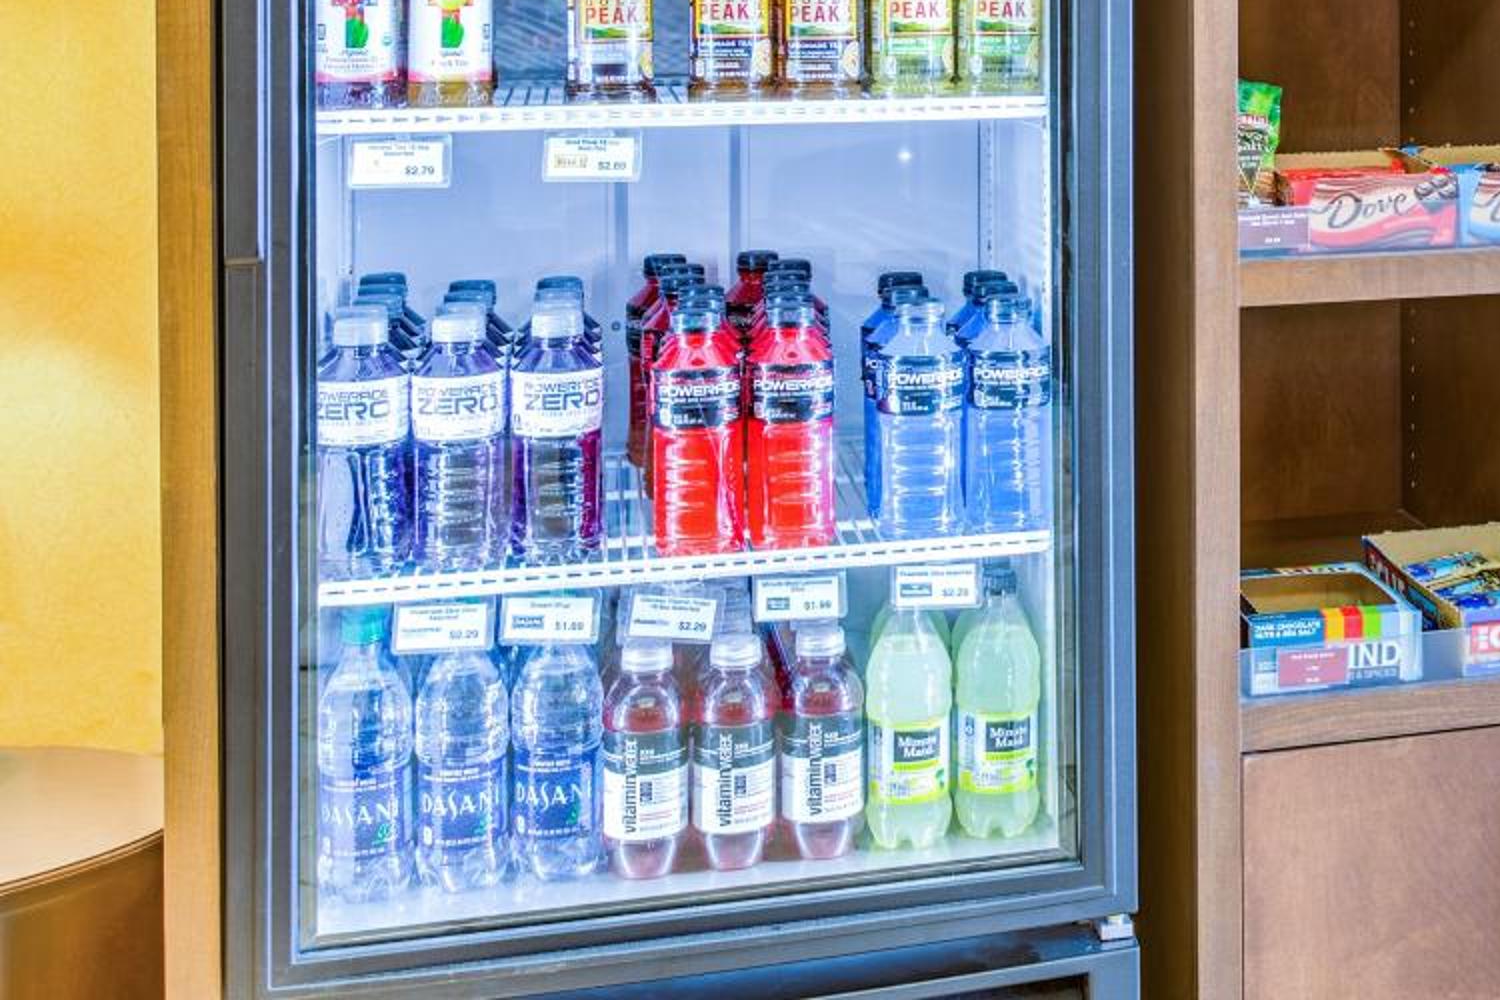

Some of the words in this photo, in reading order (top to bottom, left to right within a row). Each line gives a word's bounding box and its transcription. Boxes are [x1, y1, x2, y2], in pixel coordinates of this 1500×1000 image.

[585, 6, 637, 25] PEAK
[700, 3, 750, 20] PEAK
[790, 4, 839, 22] PEAK
[889, 1, 941, 19] PEAK
[977, 1, 1026, 19] PEAK
[659, 380, 740, 399] POWERADE
[753, 374, 833, 393] POWERADE
[318, 388, 389, 403] OWERADE
[418, 394, 499, 416] ZERO
[525, 389, 601, 412] ZERO
[1349, 642, 1401, 668] IND
[718, 733, 734, 827] vitaminwater
[808, 724, 824, 816] vitaminwater
[624, 737, 640, 834] vitaminwater
[422, 788, 499, 818] DASANI
[516, 782, 592, 810] DASANI
